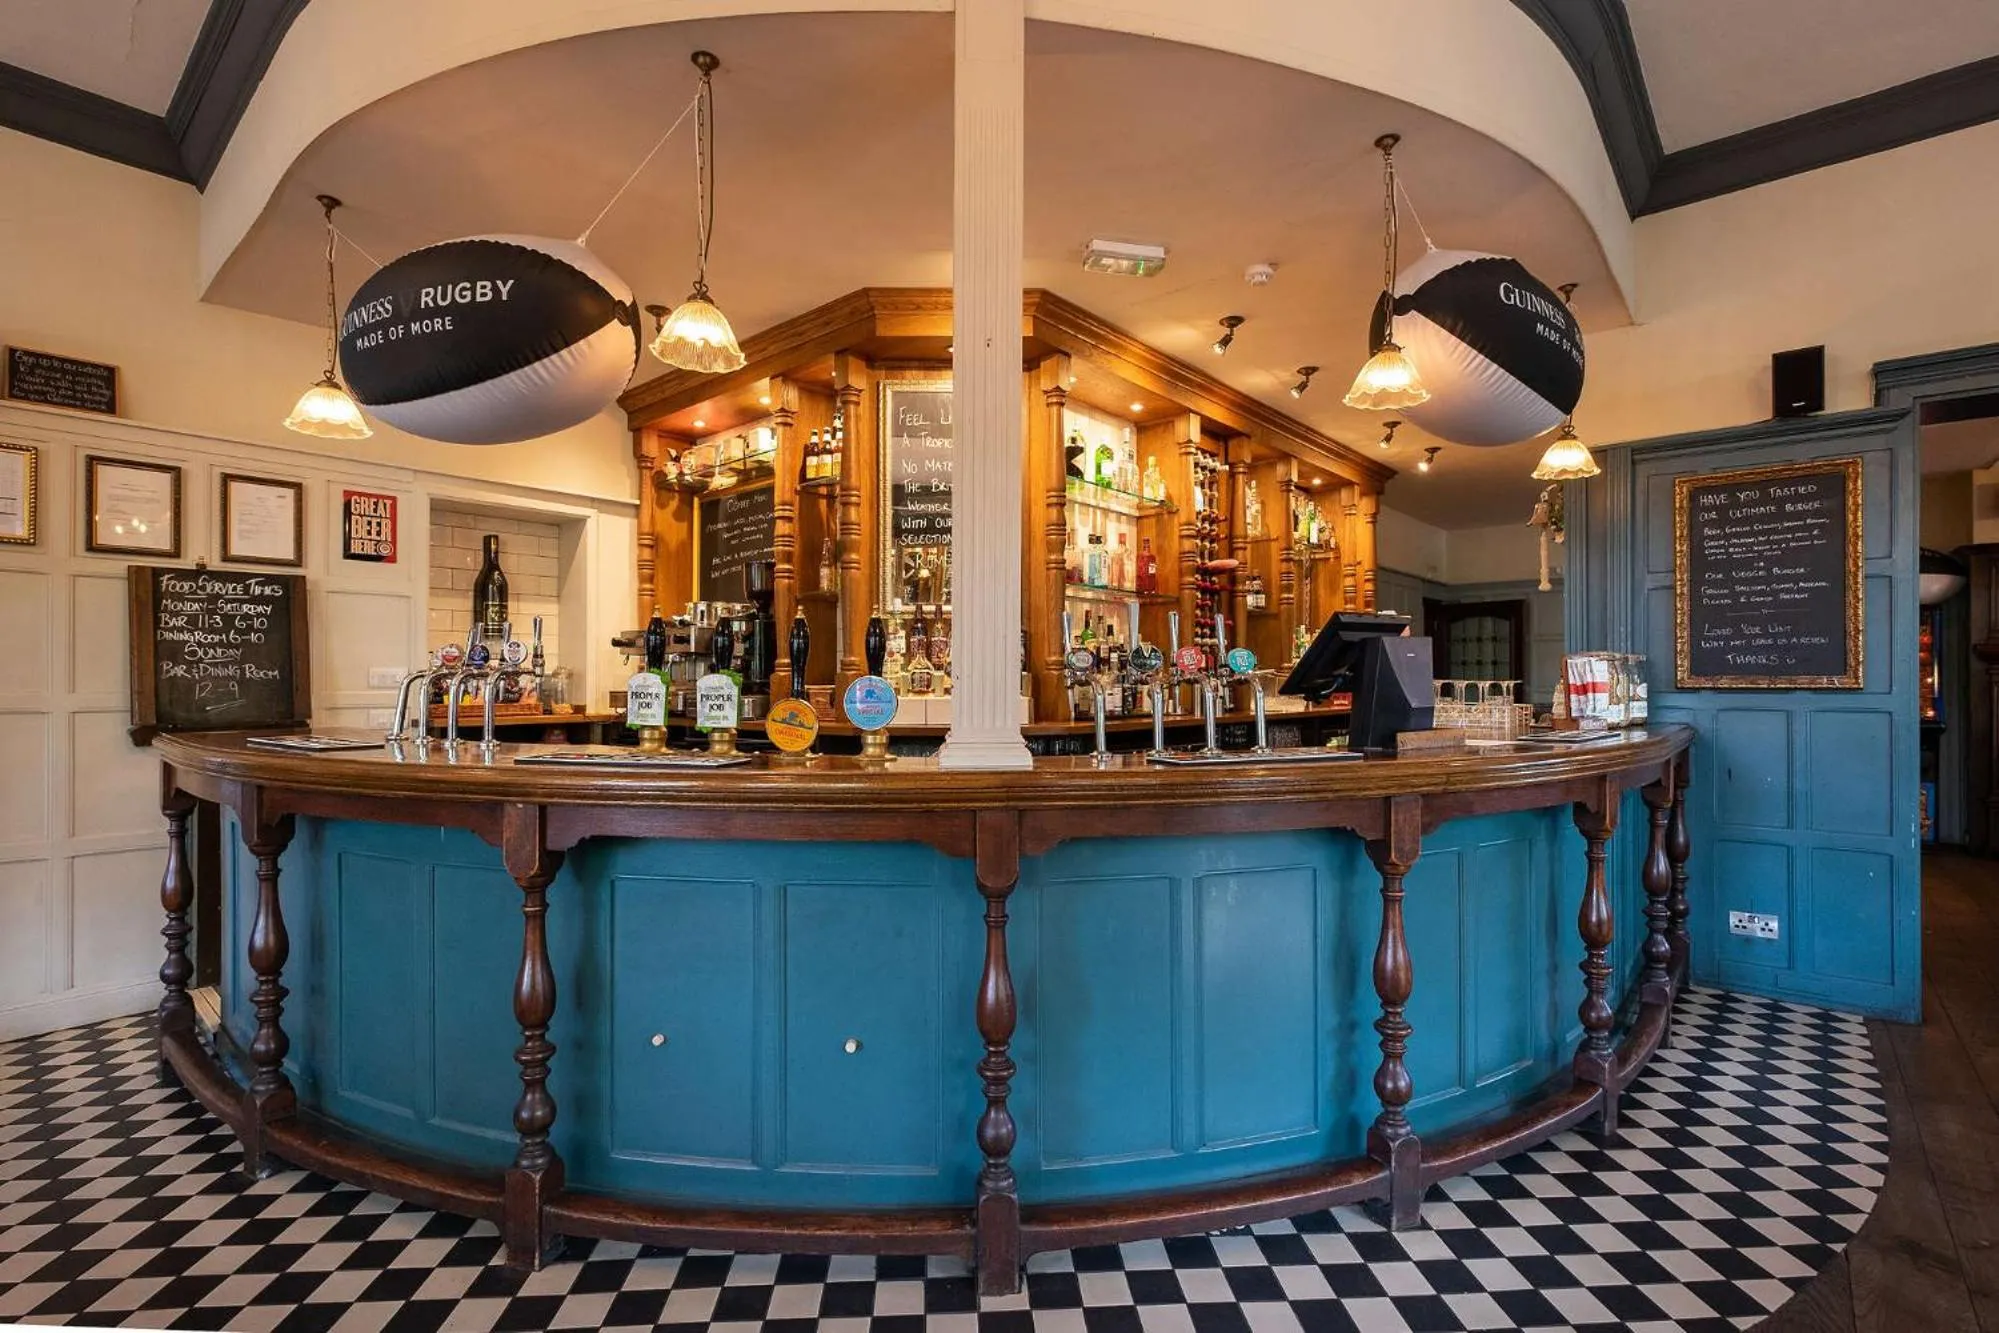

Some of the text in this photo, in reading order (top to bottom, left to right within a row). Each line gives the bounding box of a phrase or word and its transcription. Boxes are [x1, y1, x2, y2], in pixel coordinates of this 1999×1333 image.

[420, 280, 514, 309] RUGBY
[1499, 282, 1566, 329] GUINNESS
[356, 316, 454, 351] MADE OF MORE
[1536, 322, 1560, 345] MADE
[899, 406, 931, 426] FEEL
[902, 457, 918, 474] NO
[1700, 494, 1728, 506] HAVE
[1736, 489, 1760, 501] YOU
[351, 496, 393, 517] GREAT
[1700, 511, 1717, 521] OUR
[1729, 505, 1777, 519] ULTIMATE
[351, 515, 391, 541] BEER
[901, 517, 927, 529] WITH
[351, 538, 378, 555] HERE
[160, 574, 196, 593] FOOD
[197, 575, 244, 595] SERVICE
[159, 612, 194, 629] BAR
[184, 643, 242, 661] SUNDAY
[1726, 652, 1779, 665] THANKS
[160, 661, 191, 679] BAR
[242, 663, 279, 680] ROOM
[631, 691, 660, 701] PROPER
[700, 691, 733, 702] PROPER
[637, 701, 652, 711] JOB
[708, 703, 725, 714] JOB
